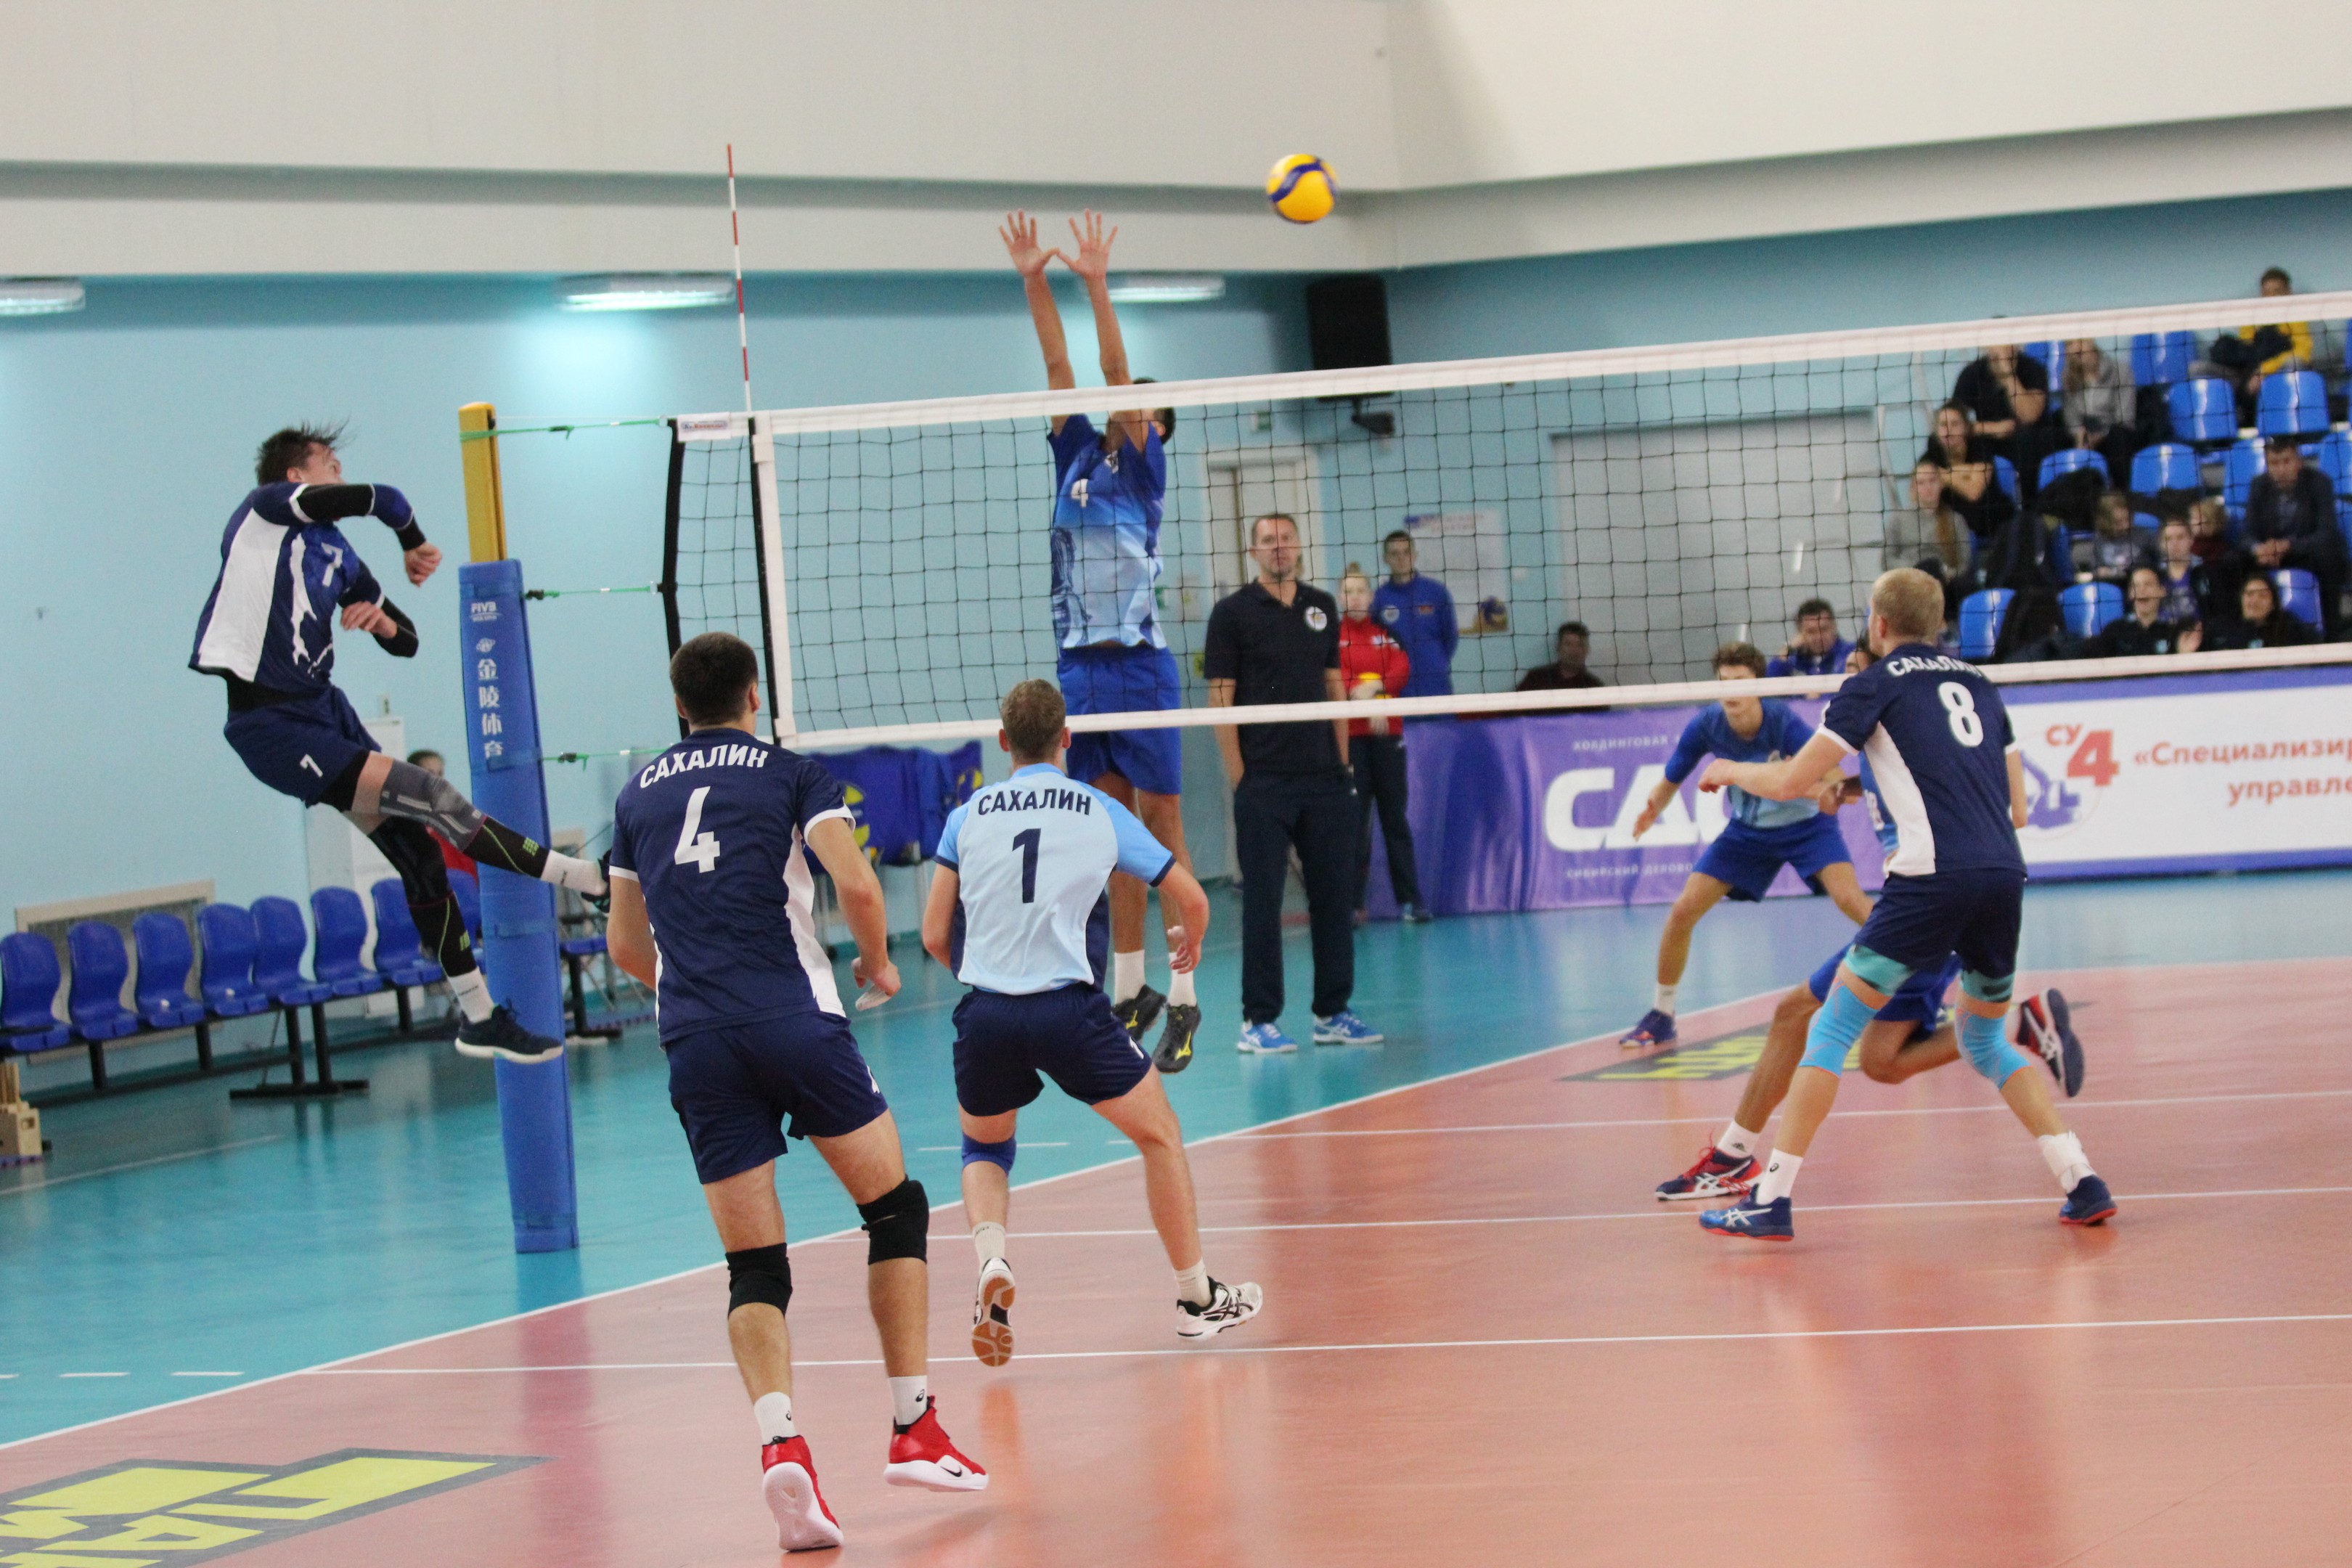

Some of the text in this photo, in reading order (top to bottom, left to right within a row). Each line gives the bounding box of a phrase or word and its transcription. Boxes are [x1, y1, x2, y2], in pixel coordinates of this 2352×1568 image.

[1071, 478, 1089, 507] 4
[321, 542, 343, 587] 7
[471, 601, 497, 613] FIVB
[1887, 656, 1983, 677] САХАЛИН
[1938, 681, 1984, 748] 8
[300, 754, 323, 777] 7
[640, 744, 768, 788] САХАЛИН
[2046, 724, 2119, 787] СУ 4
[978, 788, 1091, 815] САХАЛИН
[674, 786, 720, 873] 4
[1012, 828, 1041, 904] 1
